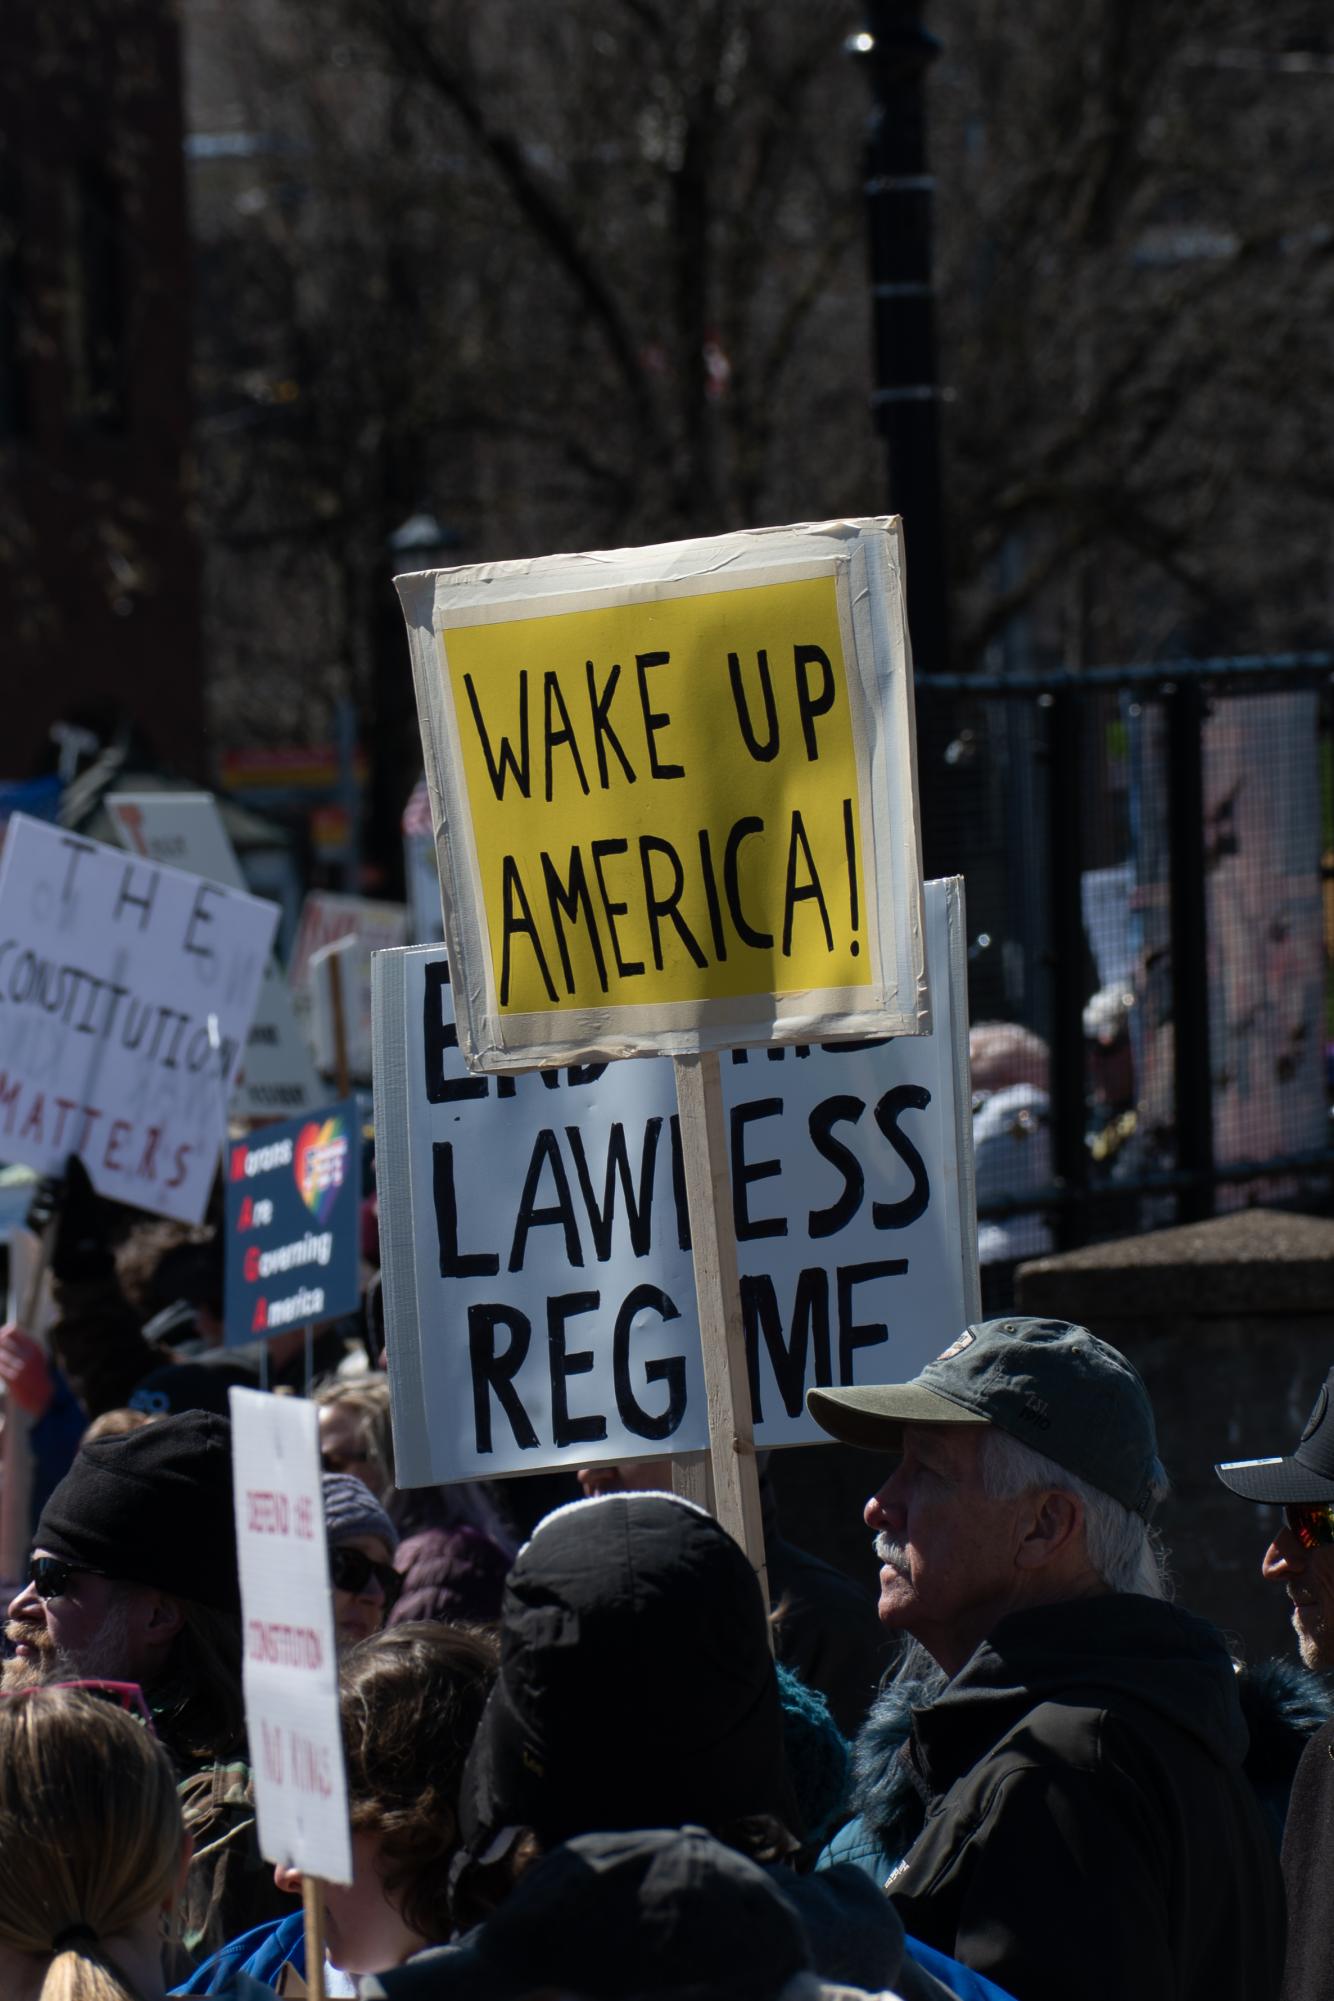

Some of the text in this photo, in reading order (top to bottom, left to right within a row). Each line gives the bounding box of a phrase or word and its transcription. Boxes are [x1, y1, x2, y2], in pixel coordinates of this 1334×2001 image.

[463, 644, 836, 802] WAKE UP
[60, 836, 228, 957] THE
[500, 798, 860, 1007] AMERICA!
[252, 1286, 324, 1333] America
[467, 1259, 908, 1454] REGME
